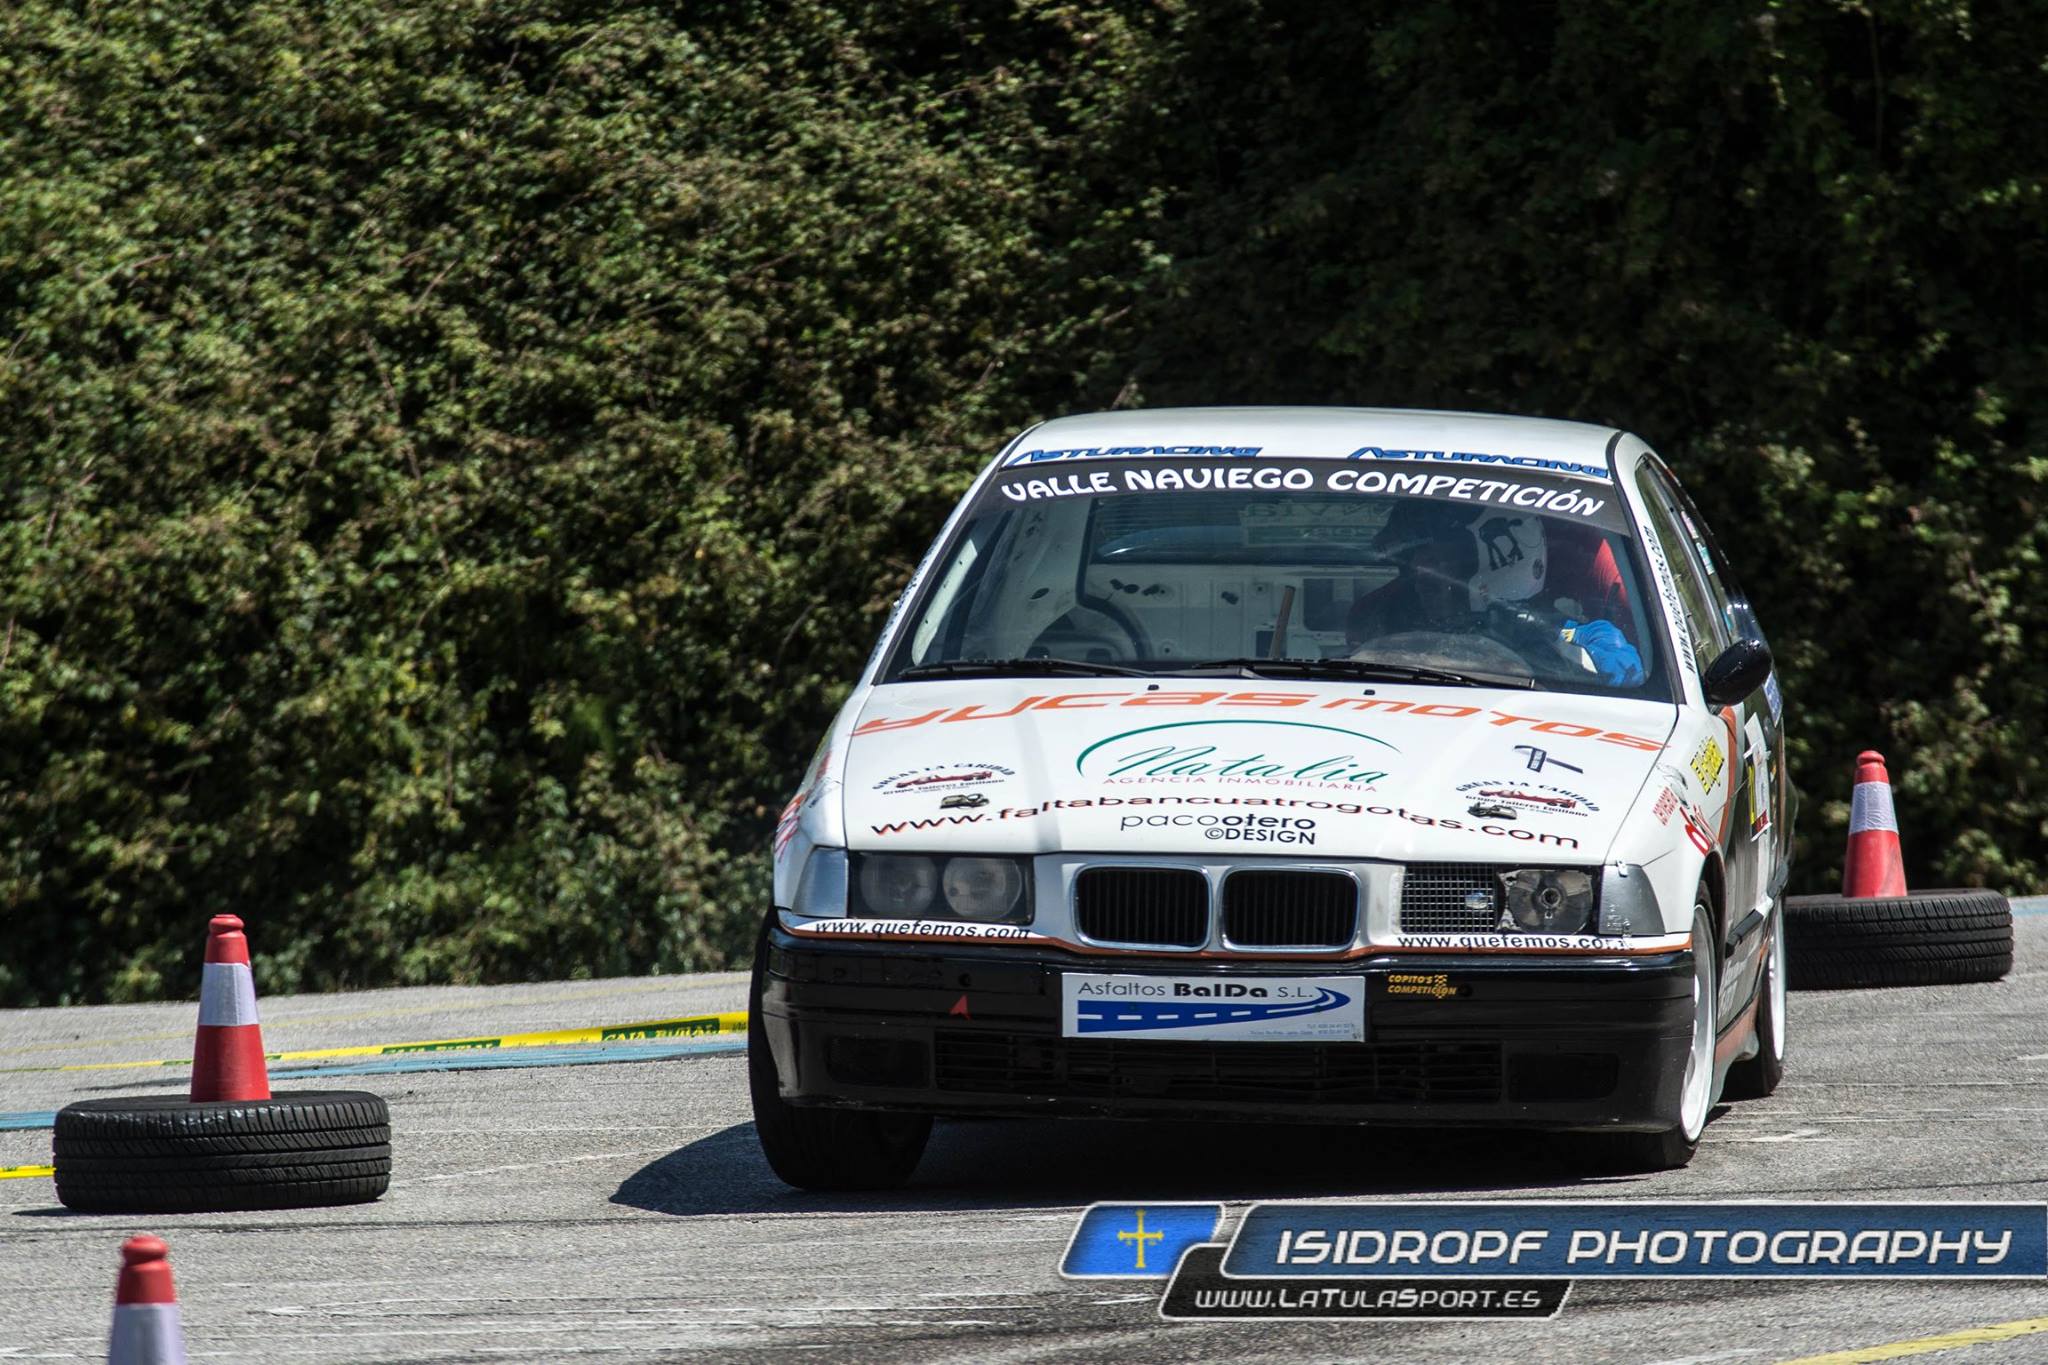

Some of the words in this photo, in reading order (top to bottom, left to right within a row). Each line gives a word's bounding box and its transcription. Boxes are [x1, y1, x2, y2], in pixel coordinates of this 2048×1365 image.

[1001, 472, 1118, 501] VALLE
[1124, 467, 1315, 491] NAVIEGO
[1327, 470, 1604, 516] COMPETICIÓN
[1108, 745, 1389, 784] Natalia
[1102, 776, 1206, 785] AGENCIA
[1217, 776, 1378, 793] INMOBILIARIA
[870, 795, 1579, 850] www.faltabancuatrogotas.com
[815, 920, 1030, 939] www.quefemos.com
[1077, 981, 1165, 997] Asfaltos
[1173, 982, 1268, 998] BalDa
[1276, 986, 1314, 998] S.L.
